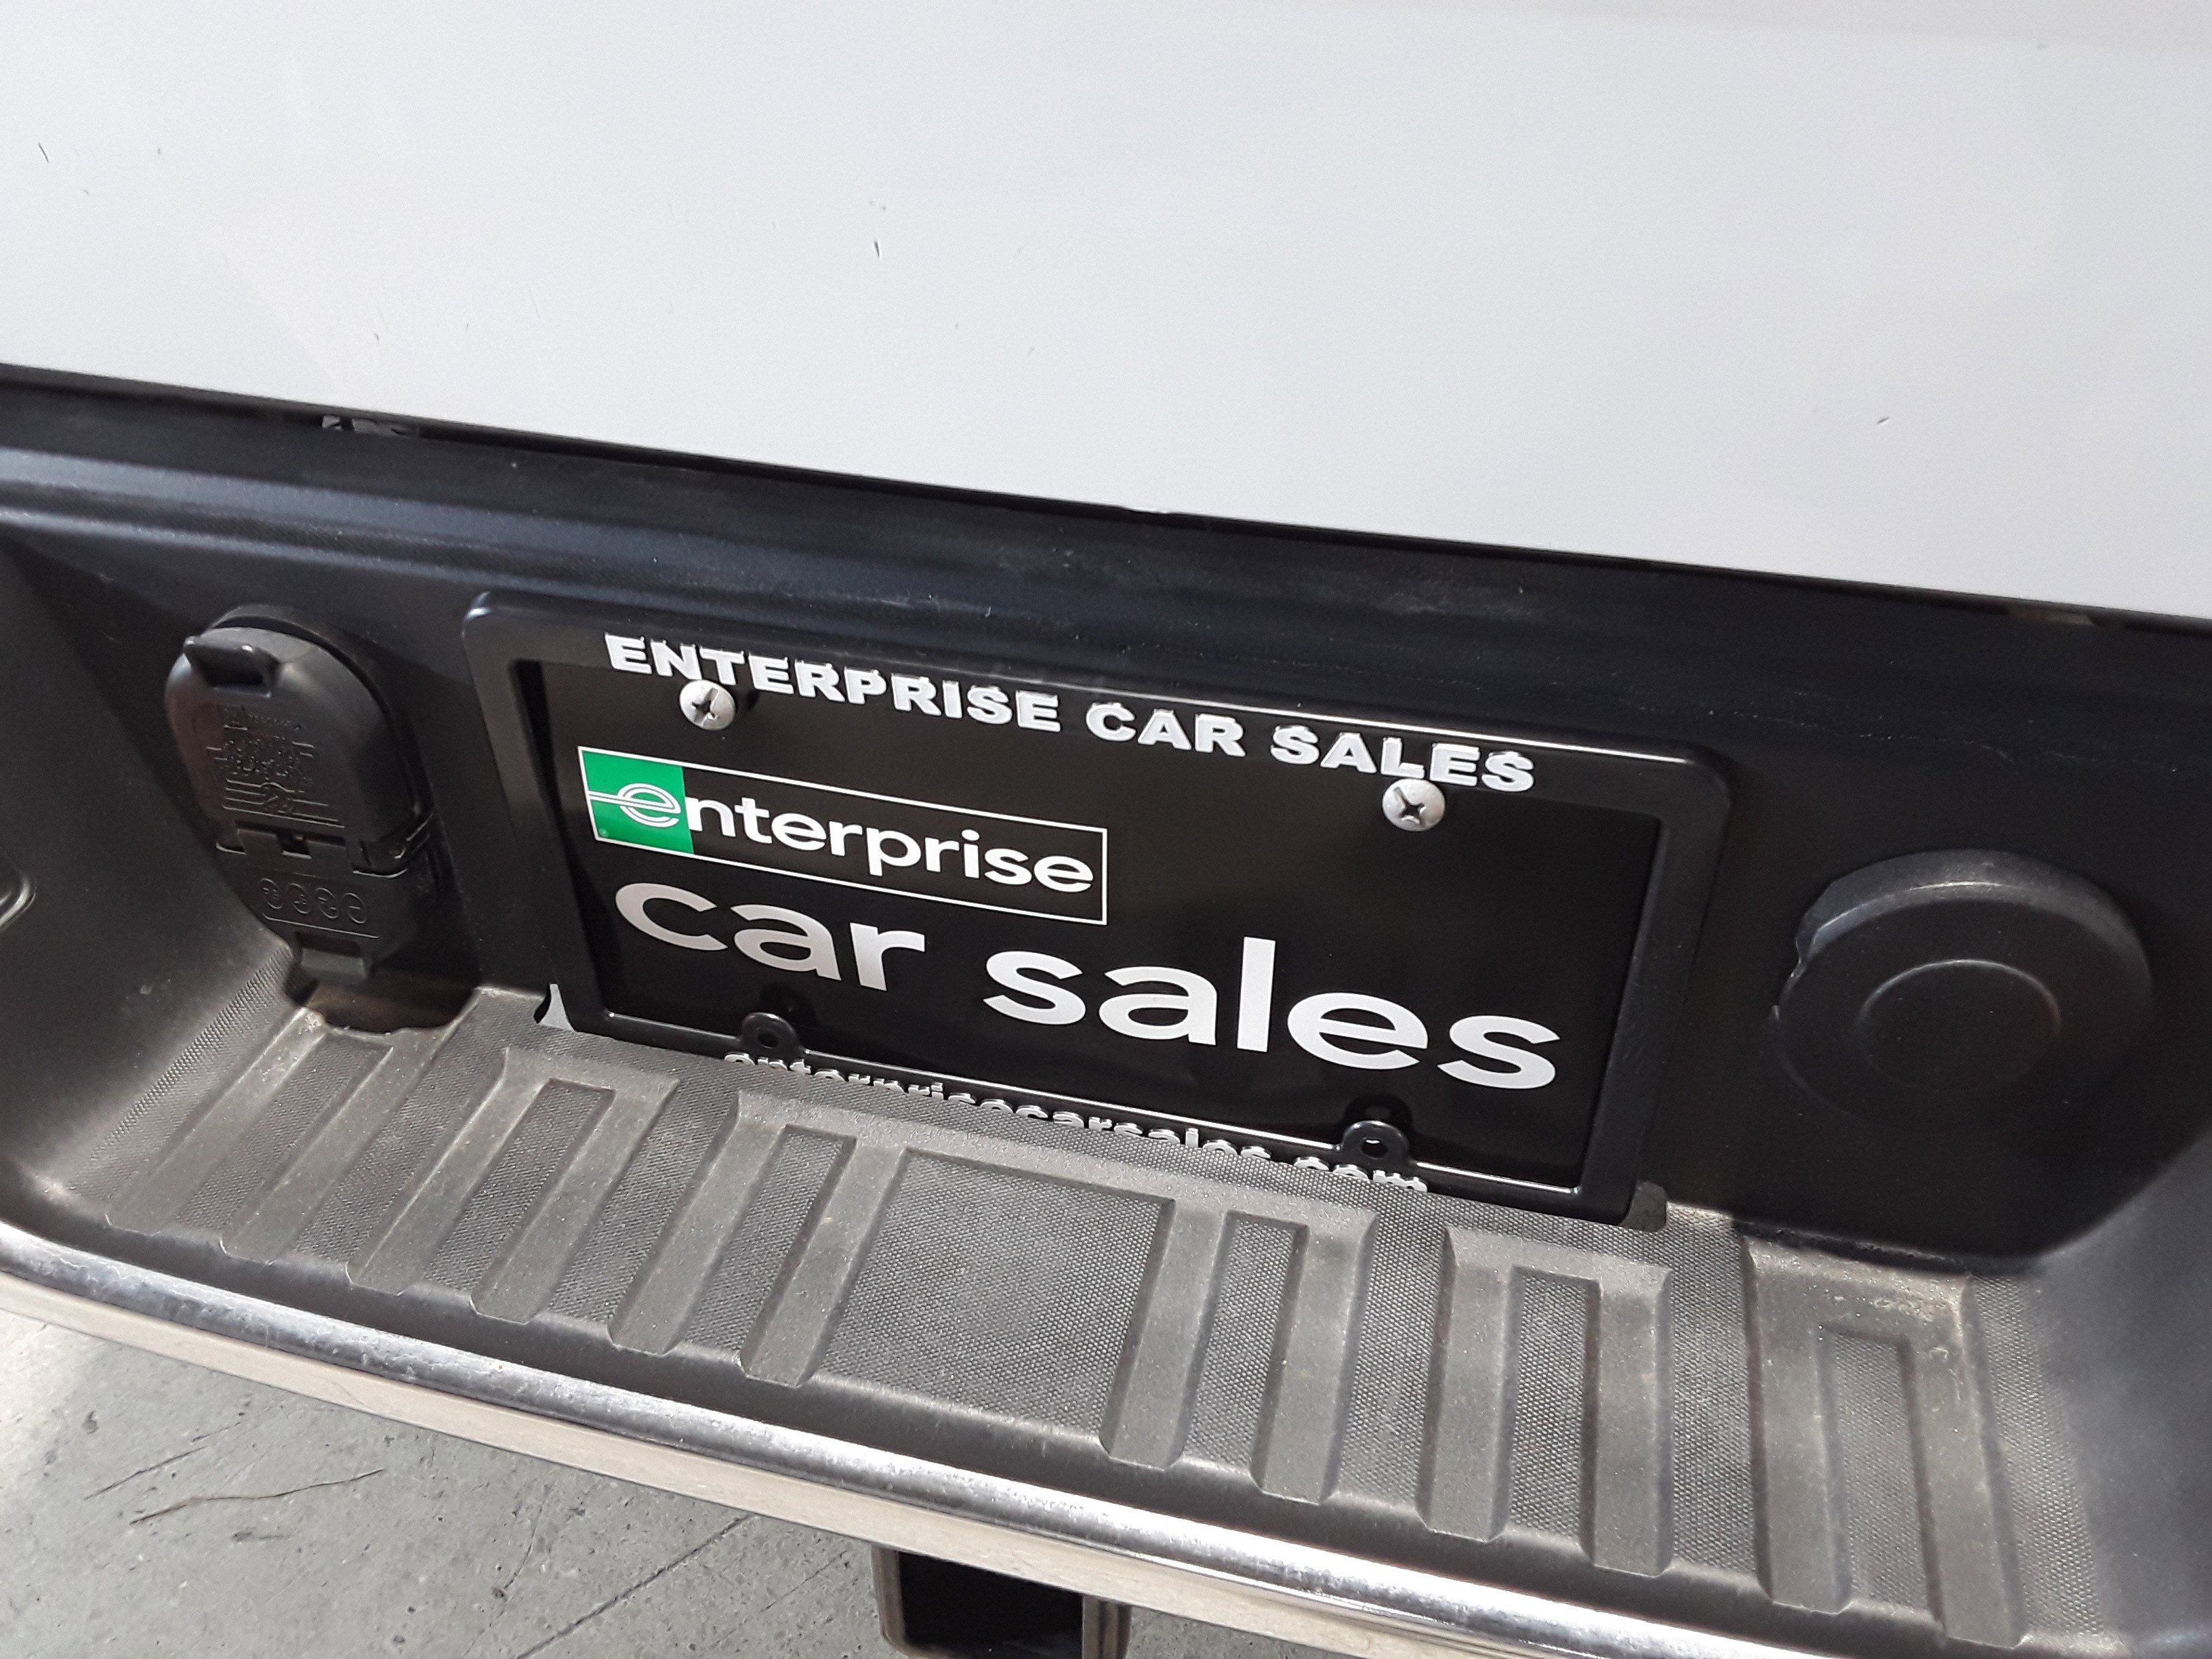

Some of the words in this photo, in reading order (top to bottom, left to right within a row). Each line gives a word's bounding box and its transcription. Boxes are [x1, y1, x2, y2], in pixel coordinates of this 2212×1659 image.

[605, 633, 1061, 732] ENTERPRISE
[1086, 702, 1246, 756] CAR
[1271, 724, 1534, 792] SALES
[587, 783, 1094, 893] enterprise
[615, 883, 925, 991] car
[983, 937, 1560, 1089] sales
